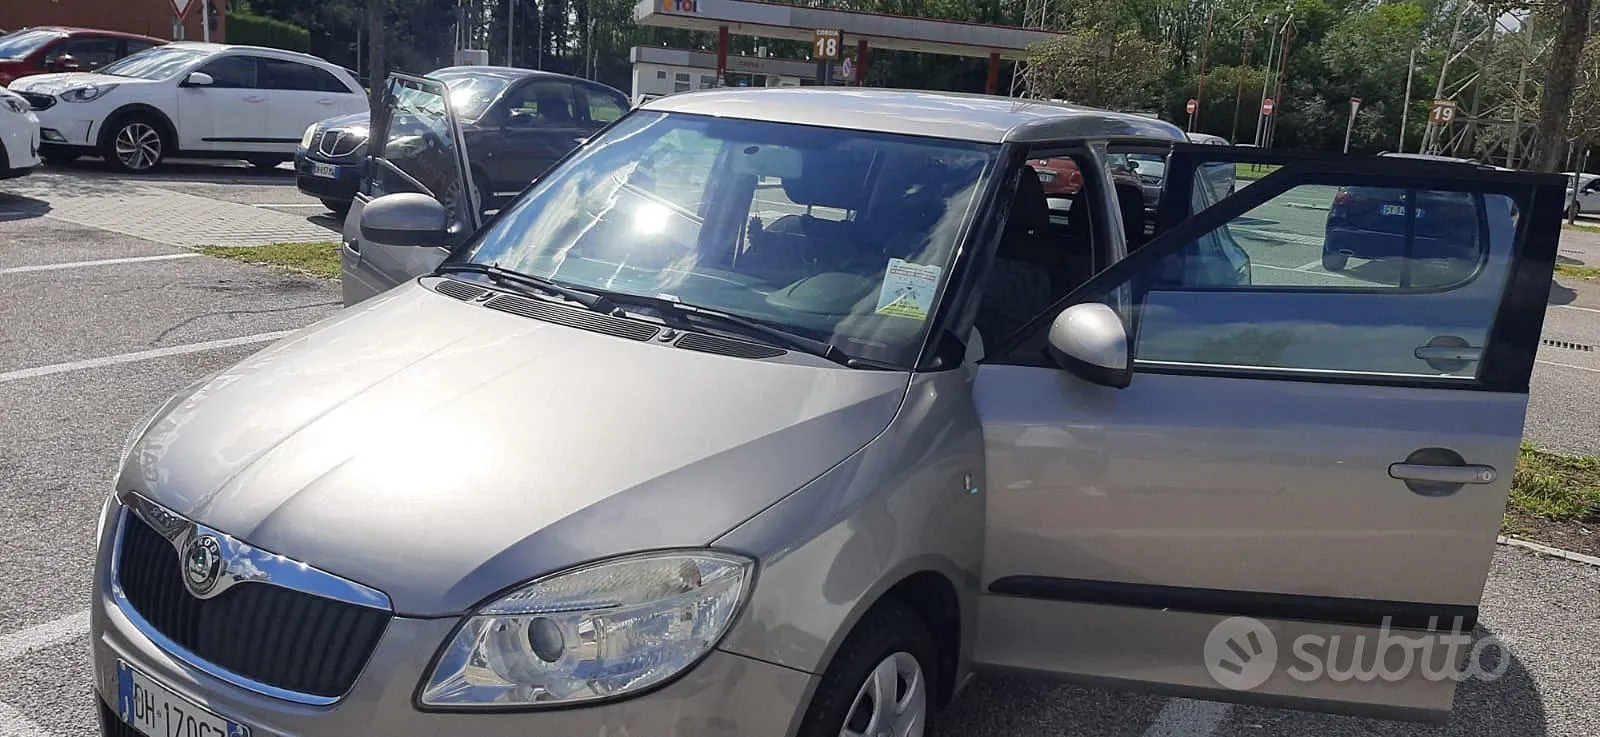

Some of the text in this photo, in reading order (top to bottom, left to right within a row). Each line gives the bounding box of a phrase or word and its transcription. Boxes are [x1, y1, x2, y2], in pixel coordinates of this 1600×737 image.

[816, 37, 837, 56] 18
[1433, 106, 1453, 121] 19
[134, 682, 156, 729] DH
